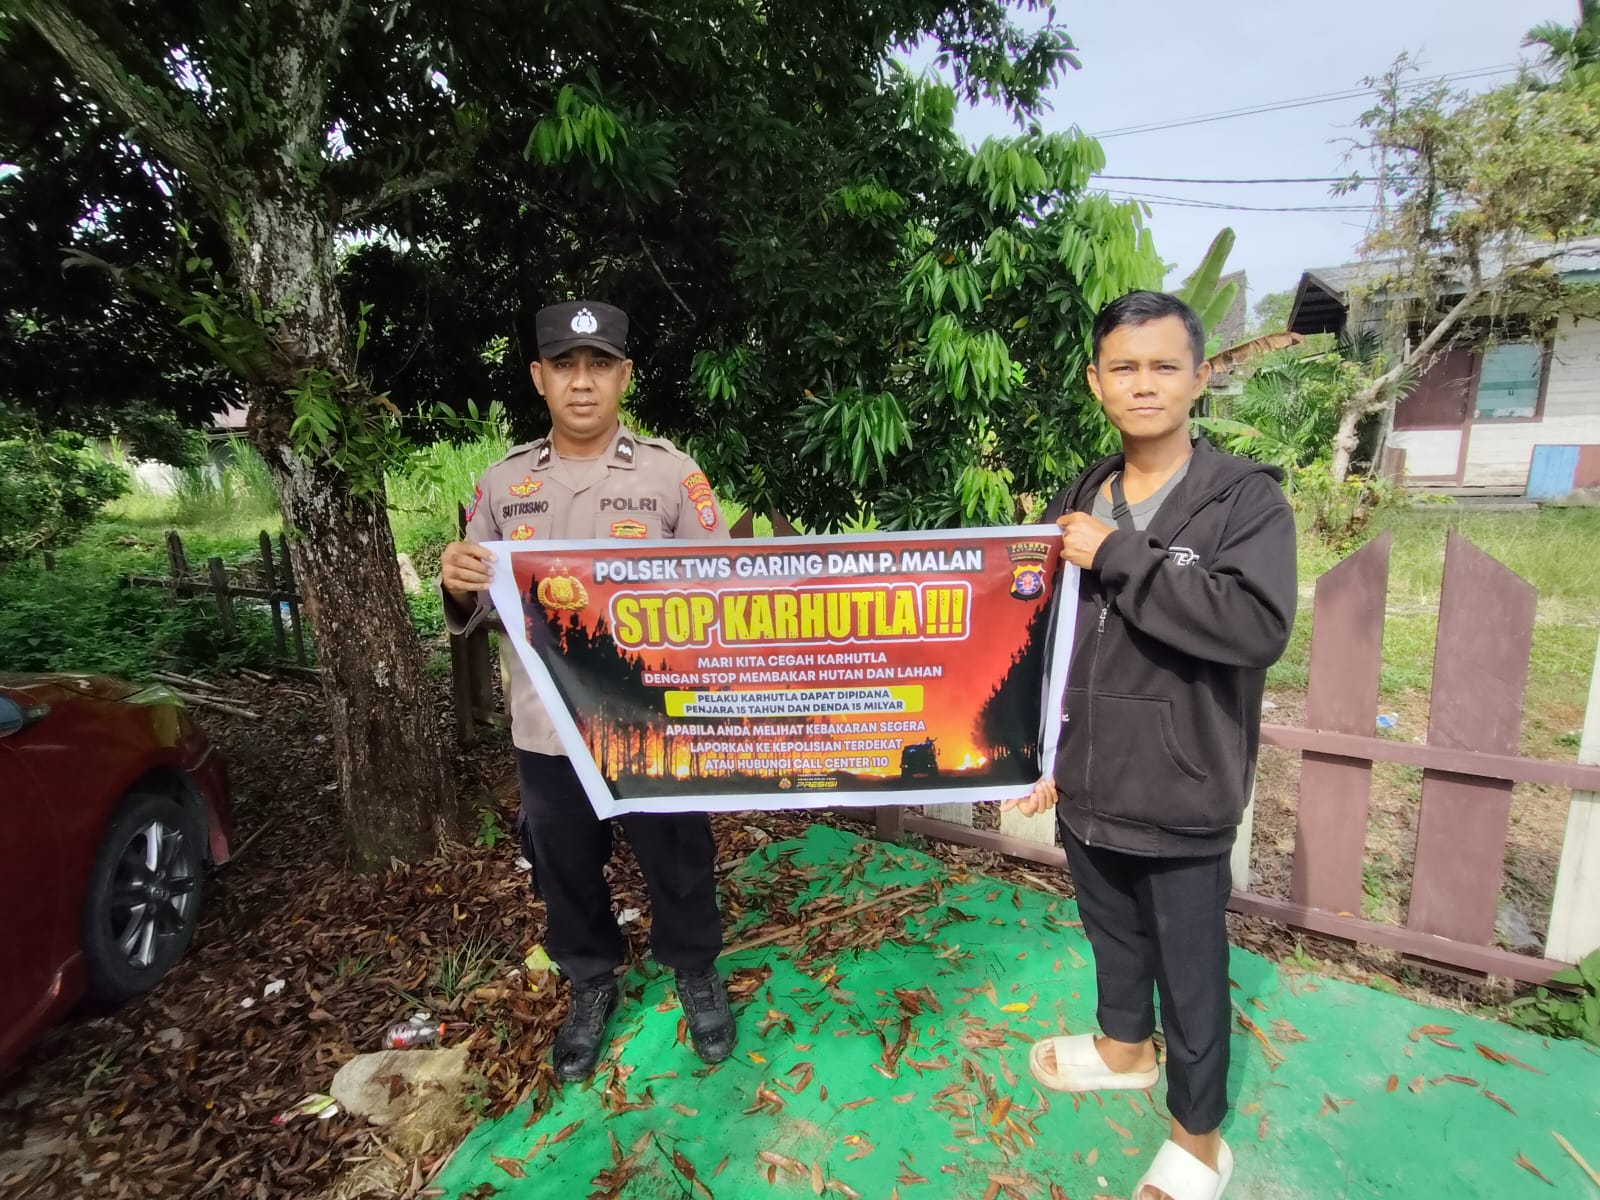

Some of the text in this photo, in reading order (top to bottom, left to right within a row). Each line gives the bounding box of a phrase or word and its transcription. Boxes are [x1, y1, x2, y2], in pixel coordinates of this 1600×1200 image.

[600, 497, 657, 511] POLRI
[595, 550, 982, 582] POLSEK TWS GARING DAN P. MALAN
[616, 589, 964, 643] STOP KARHUTLA !!!
[698, 652, 887, 668] MARI KITA CEGAH KARHUTLA
[644, 666, 942, 684] DENGAN STOP MEMBAKAR HUTAN DAN LAHAN
[697, 690, 890, 703] PELAKU KARHUTLA DAPAT DIPIDANA
[686, 701, 903, 714] PENJARA 15 TAHUN DAN DENDA 15 MILYAR
[665, 720, 926, 736] APABILA ANDA MELIHAT KEBAKARAN SEGERA
[690, 738, 903, 753] LAPORKAN KE KEPOLISIAN TERDEKAT
[705, 756, 888, 769] ATAU HUBUNGI CALL CENTER 110
